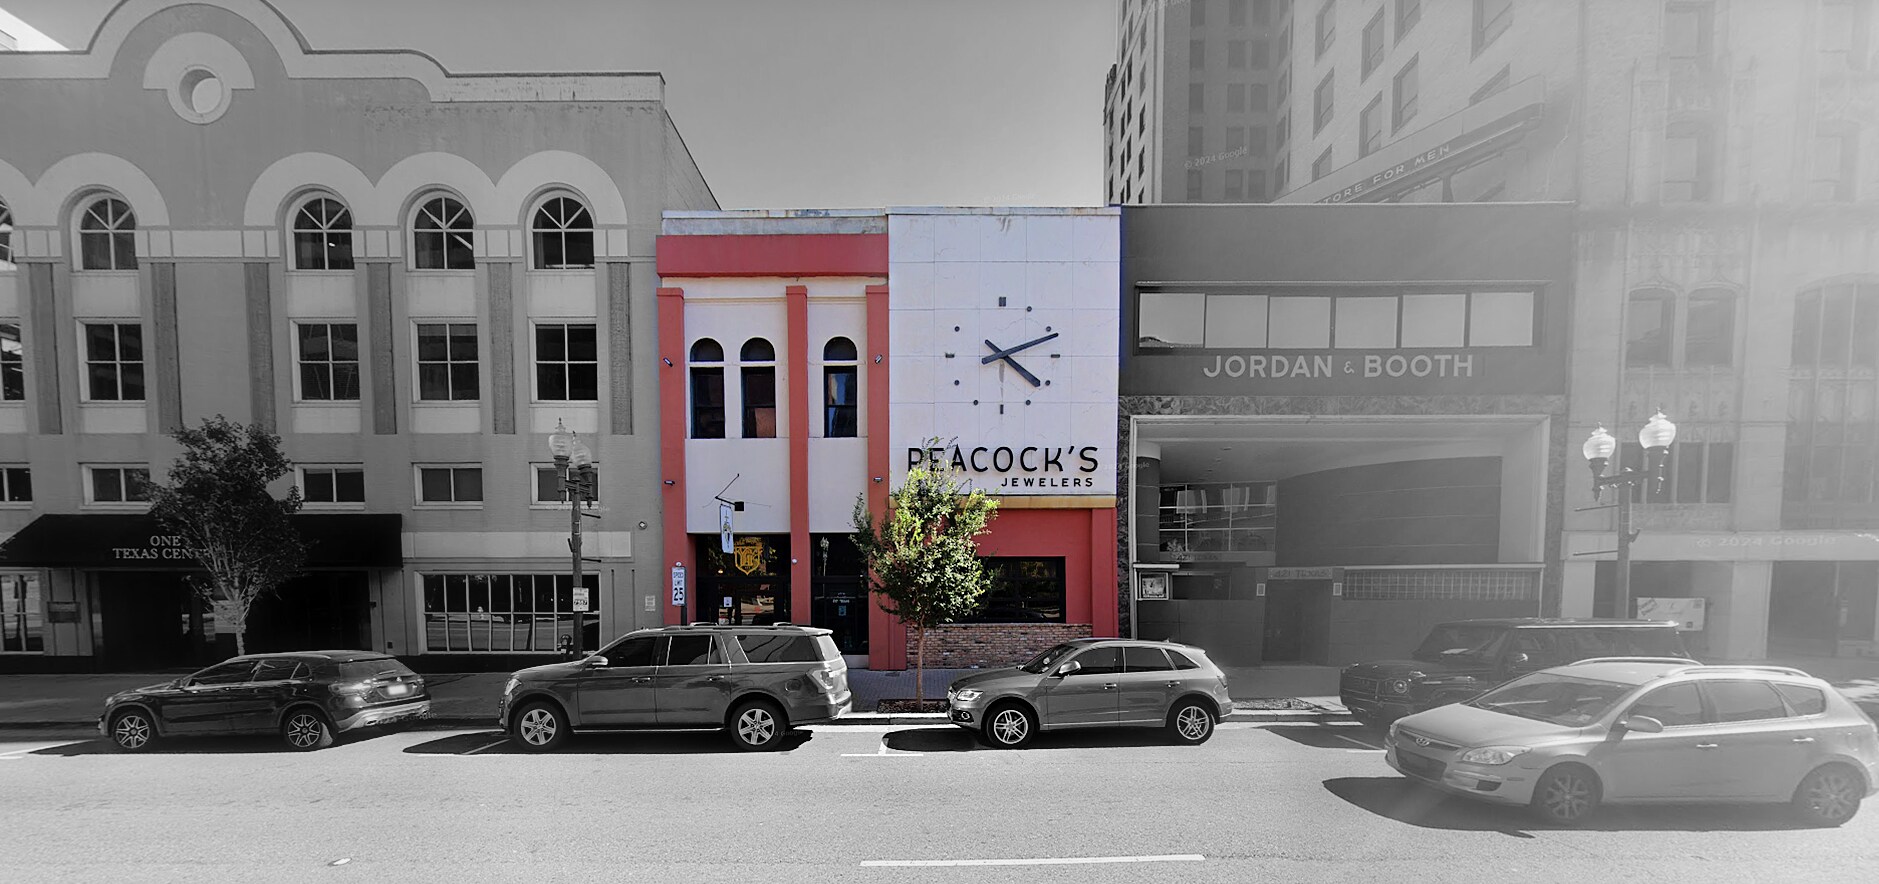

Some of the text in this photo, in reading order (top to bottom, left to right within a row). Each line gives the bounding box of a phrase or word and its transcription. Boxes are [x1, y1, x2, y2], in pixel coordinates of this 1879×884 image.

[1322, 144, 1450, 203] TORE FOR MEN
[1202, 354, 1474, 379] JORDAN & BOOTH
[907, 444, 1100, 473] PEACOCK'S
[1000, 477, 1092, 488] JEWELERS
[149, 535, 182, 547] ONE
[112, 547, 214, 560] TEXAS CENT
[673, 587, 684, 601] 25
